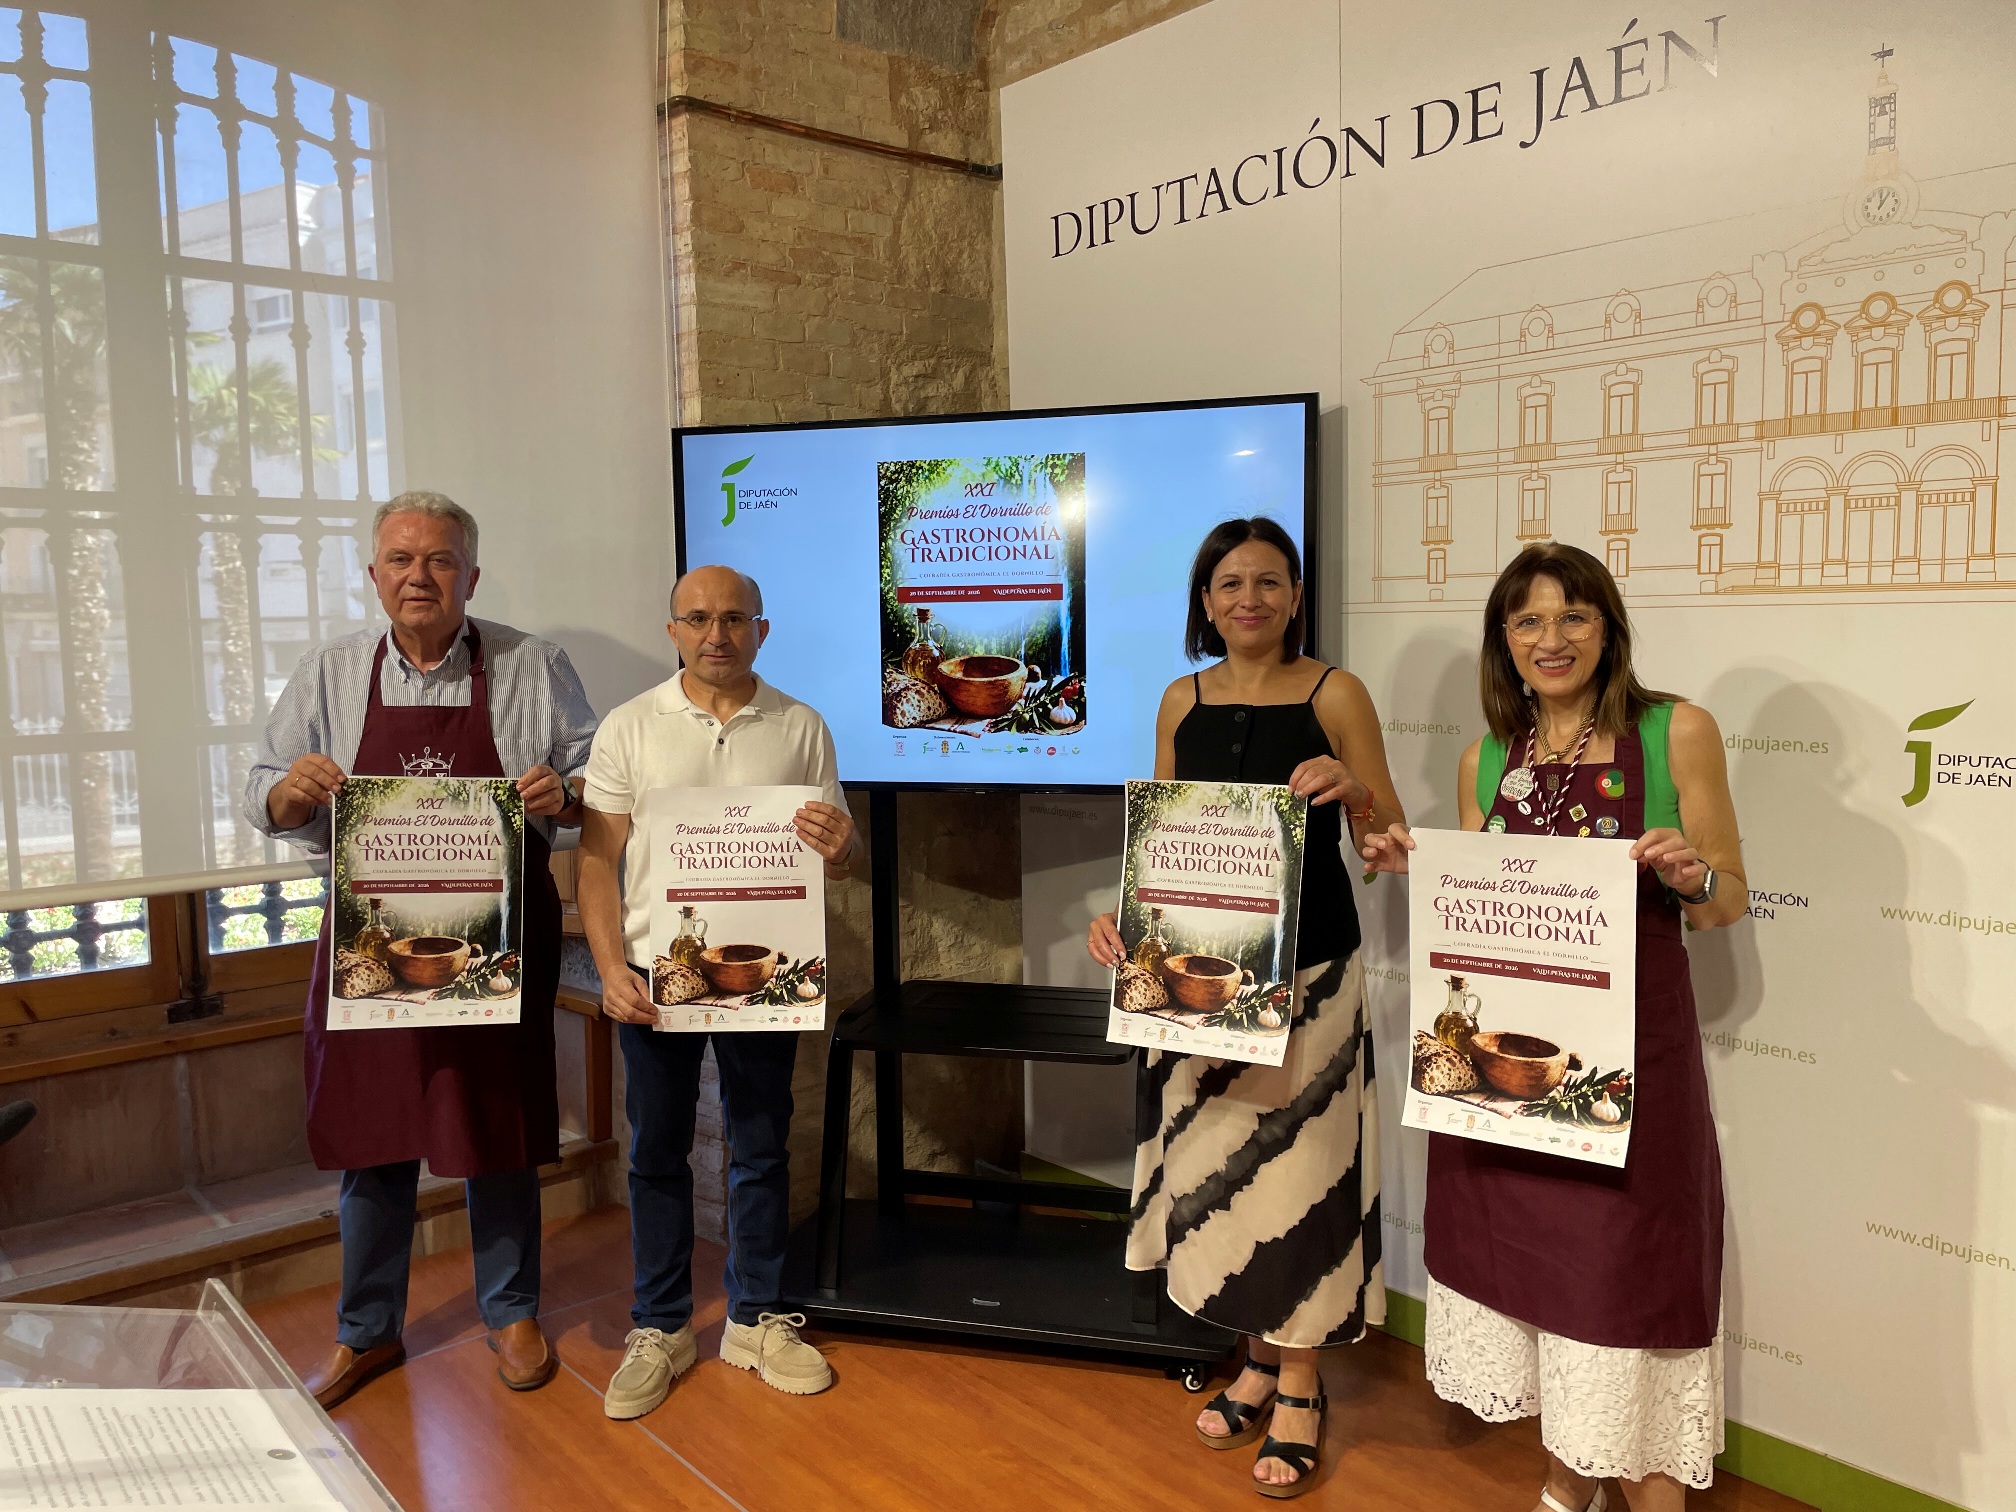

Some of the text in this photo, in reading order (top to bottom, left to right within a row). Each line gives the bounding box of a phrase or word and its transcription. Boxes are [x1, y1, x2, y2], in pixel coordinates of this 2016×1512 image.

[1050, 14, 1728, 260] DIPUTACIÓN DE JAÉN
[738, 487, 798, 498] DIPUTACIÓN
[964, 482, 997, 498] XXI
[739, 499, 778, 510] DE JAÉN
[907, 502, 1052, 520] Premios El Dornillo de
[900, 521, 1062, 549] GASTRONOMÍA
[905, 544, 1055, 564] TRADICIONAL
[1725, 734, 1828, 754] dipujaen.es
[1938, 754, 2016, 770] DIPUTAC
[1937, 772, 2012, 788] DE JAÉN
[416, 798, 446, 810] XXI
[724, 805, 752, 818] XXI
[1028, 804, 1098, 820] www.dipujaen.es
[1201, 804, 1230, 818] XXI
[362, 814, 496, 826] Premios El Dornillo de
[675, 821, 796, 835] Premios El Dornillo de
[1152, 820, 1276, 839] Premios El Dornillo de
[355, 830, 502, 850] GASTRONOMÍA
[670, 837, 804, 858] GASTRONOMÍA
[359, 848, 496, 861] TRADICIONAL
[1144, 839, 1281, 862] GASTRONOMÍA
[674, 855, 799, 870] TRADICIONAL
[1147, 855, 1275, 878] TRADICIONAL
[1501, 858, 1538, 874] XXI
[1440, 874, 1600, 900] Premios El Dornillo de
[1433, 896, 1609, 928] GASTRONOMÍA
[1880, 906, 2016, 935] www.dipujae
[1438, 914, 1602, 946] TRADICIONAL
